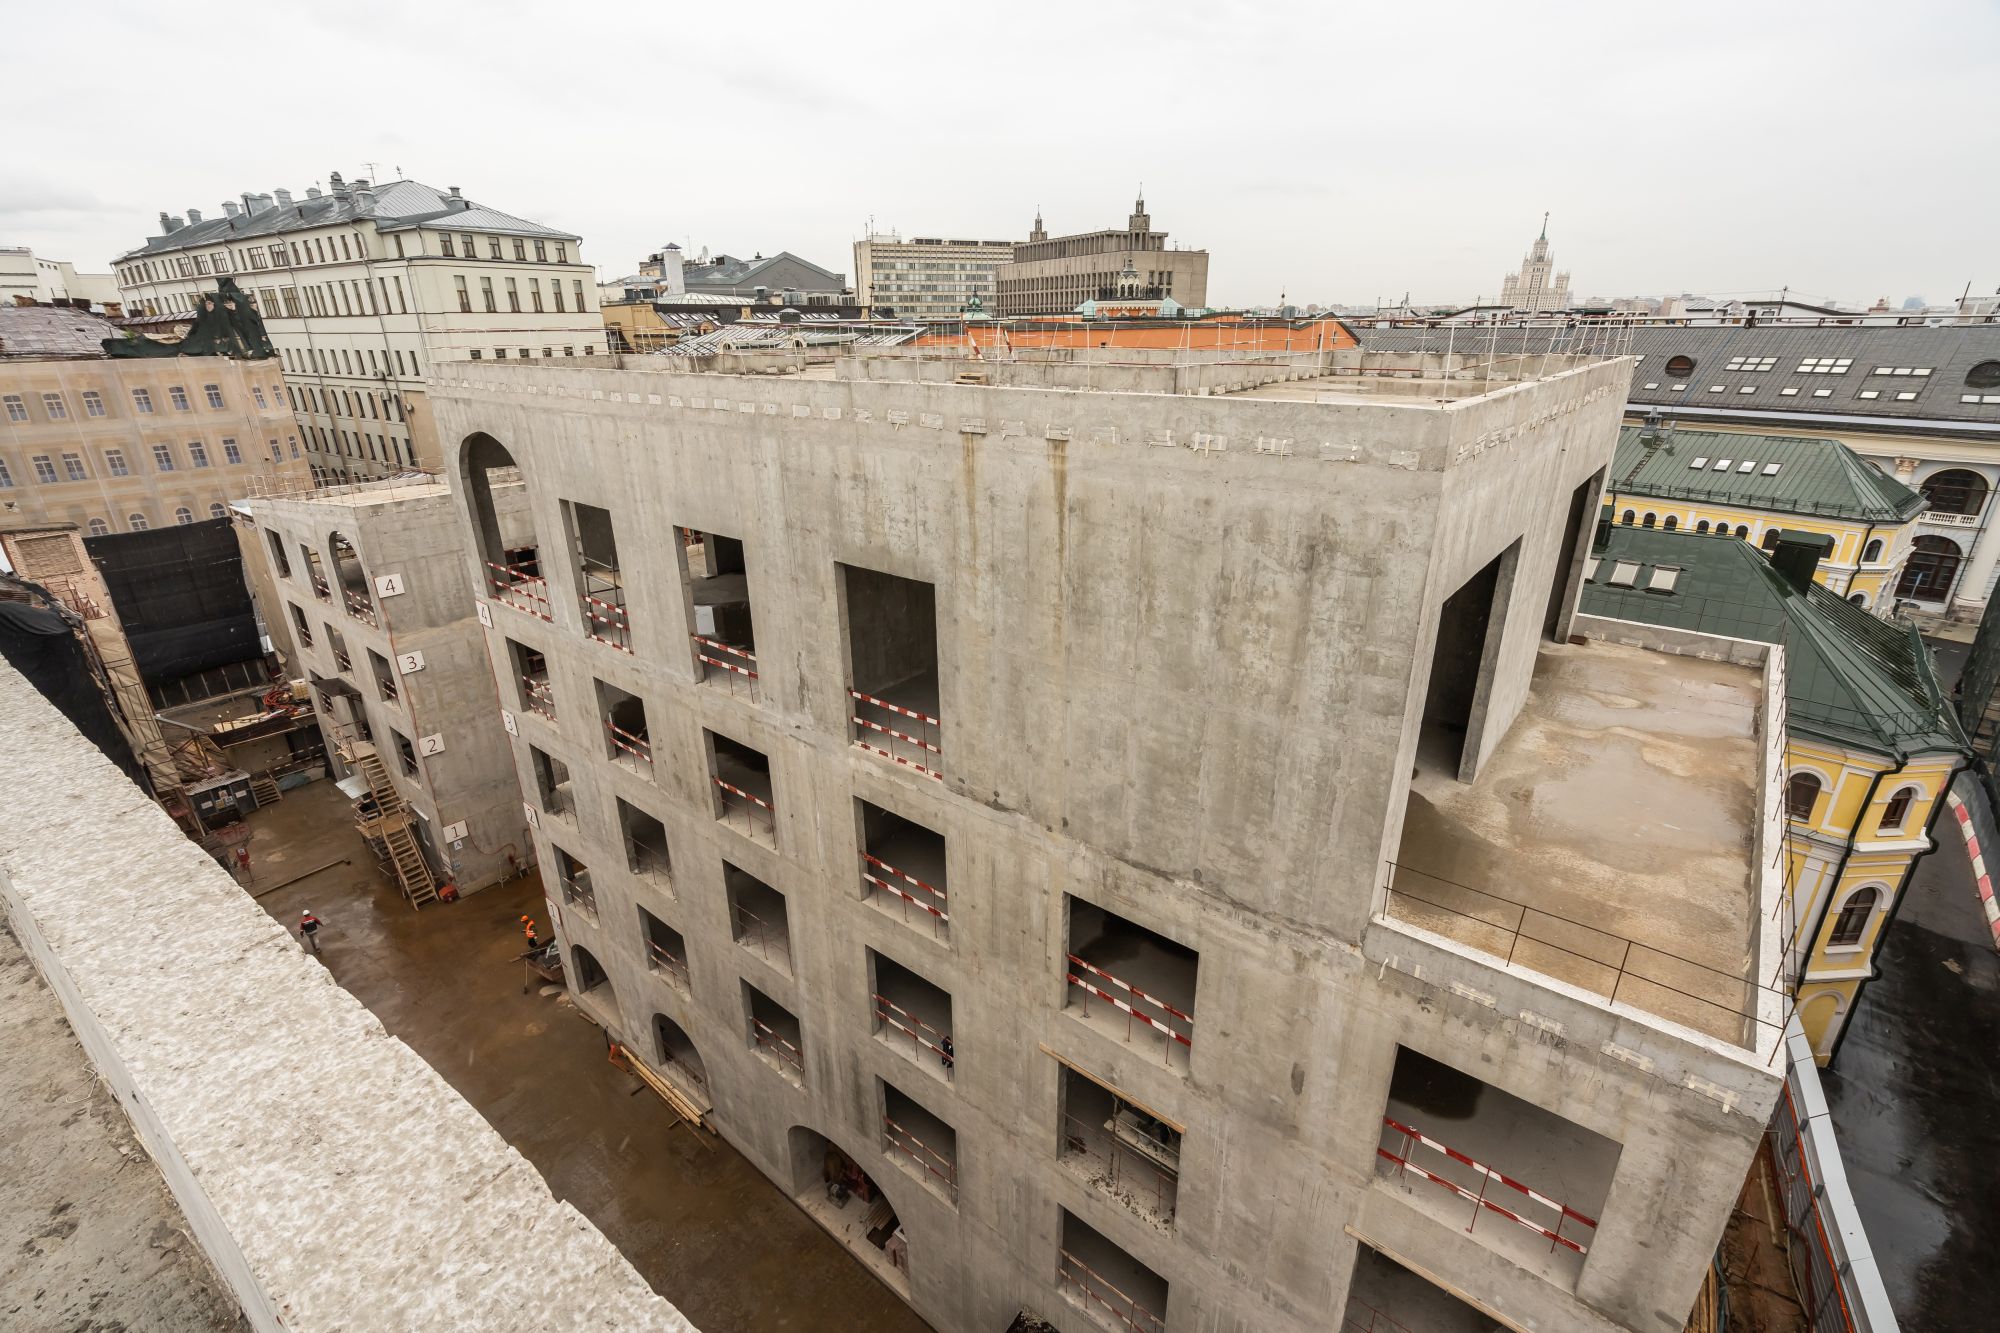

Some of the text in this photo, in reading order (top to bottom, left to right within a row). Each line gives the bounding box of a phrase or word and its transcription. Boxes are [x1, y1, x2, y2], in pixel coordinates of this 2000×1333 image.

[385, 578, 396, 593] 4
[481, 606, 488, 623] 4
[406, 655, 417, 670] 3
[506, 714, 513, 731] 3
[427, 738, 438, 753] 2
[527, 808, 535, 824] 2
[451, 825, 461, 839] 1
